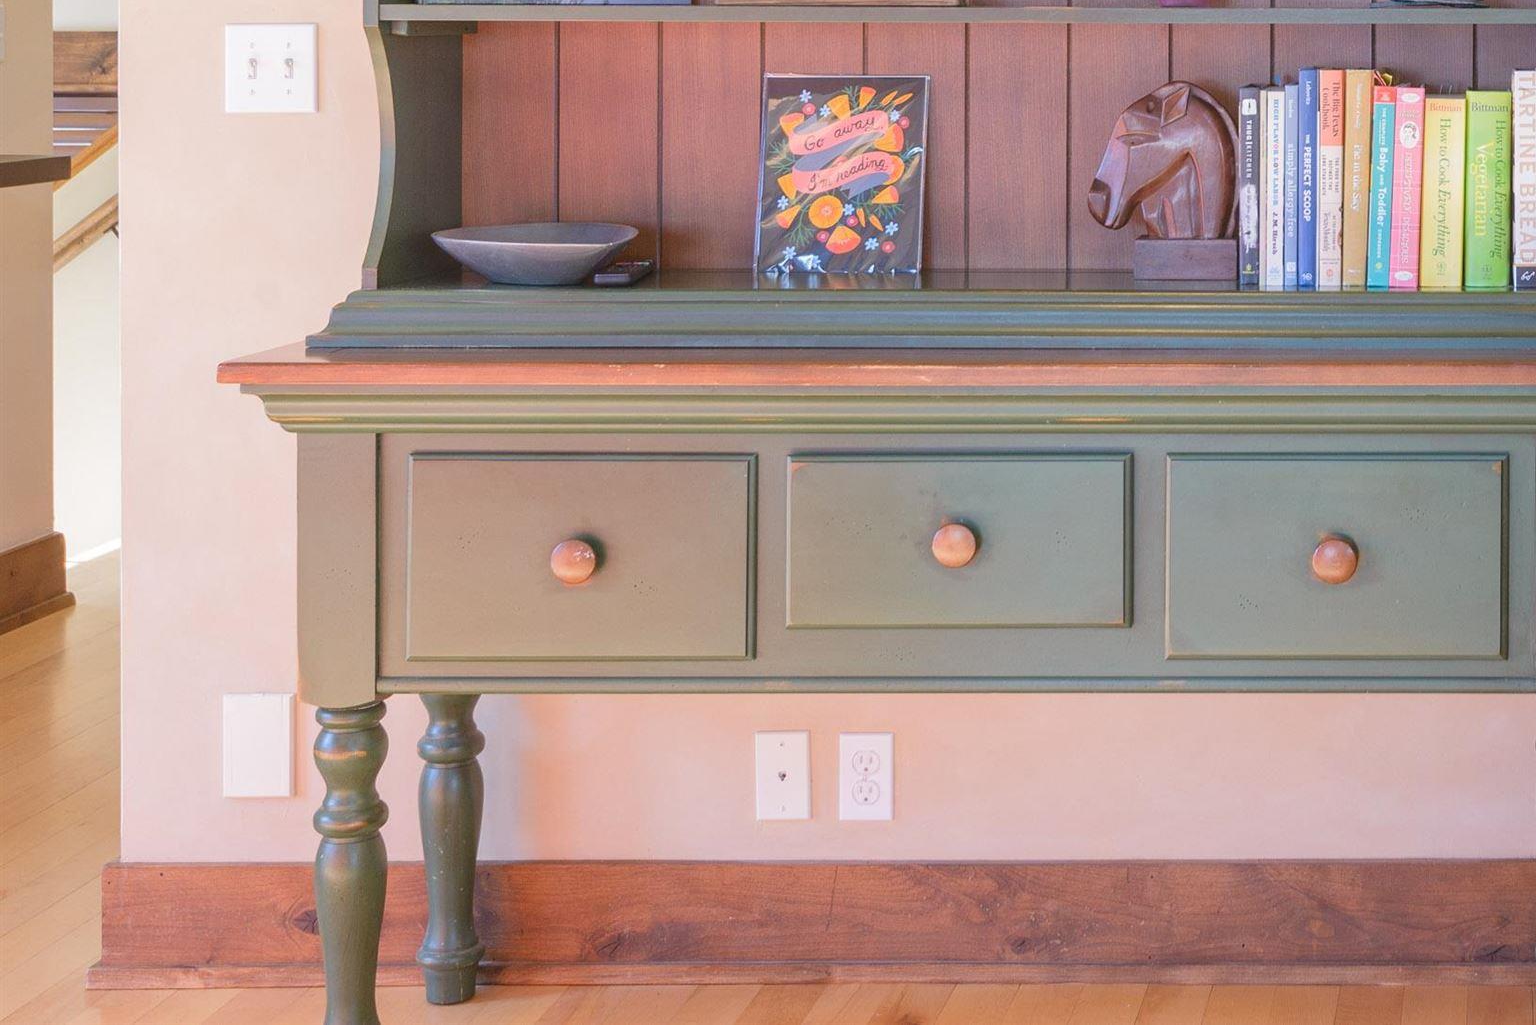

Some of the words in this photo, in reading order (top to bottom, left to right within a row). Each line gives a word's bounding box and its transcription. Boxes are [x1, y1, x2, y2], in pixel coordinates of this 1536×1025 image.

[1332, 81, 1340, 96] The
[1322, 87, 1330, 130] Cookbook
[1331, 99, 1340, 113] Big
[1429, 102, 1462, 113] Bittman
[1472, 102, 1509, 112] Bittman
[1332, 114, 1341, 137] Texas
[1439, 118, 1452, 142] How
[1495, 120, 1507, 144] How
[1517, 74, 1536, 173] TARTINE
[804, 136, 825, 151] Go
[1353, 144, 1362, 159] Pie
[1439, 145, 1449, 156] to
[1495, 146, 1504, 158] to
[1286, 143, 1297, 177] simply
[1303, 146, 1311, 187] PERFECT
[1353, 162, 1361, 172] in
[1377, 147, 1388, 172] Baby
[1353, 175, 1361, 190] the
[1438, 158, 1451, 186] Cook
[1494, 159, 1507, 187] Cook
[1470, 142, 1494, 236] Vegetarian
[1303, 189, 1312, 222] SCOOP
[1351, 192, 1361, 212] Sky
[1377, 187, 1387, 228] Toddler
[1272, 219, 1278, 227] M.
[1433, 189, 1451, 257] Everything
[1490, 190, 1507, 259] Everything
